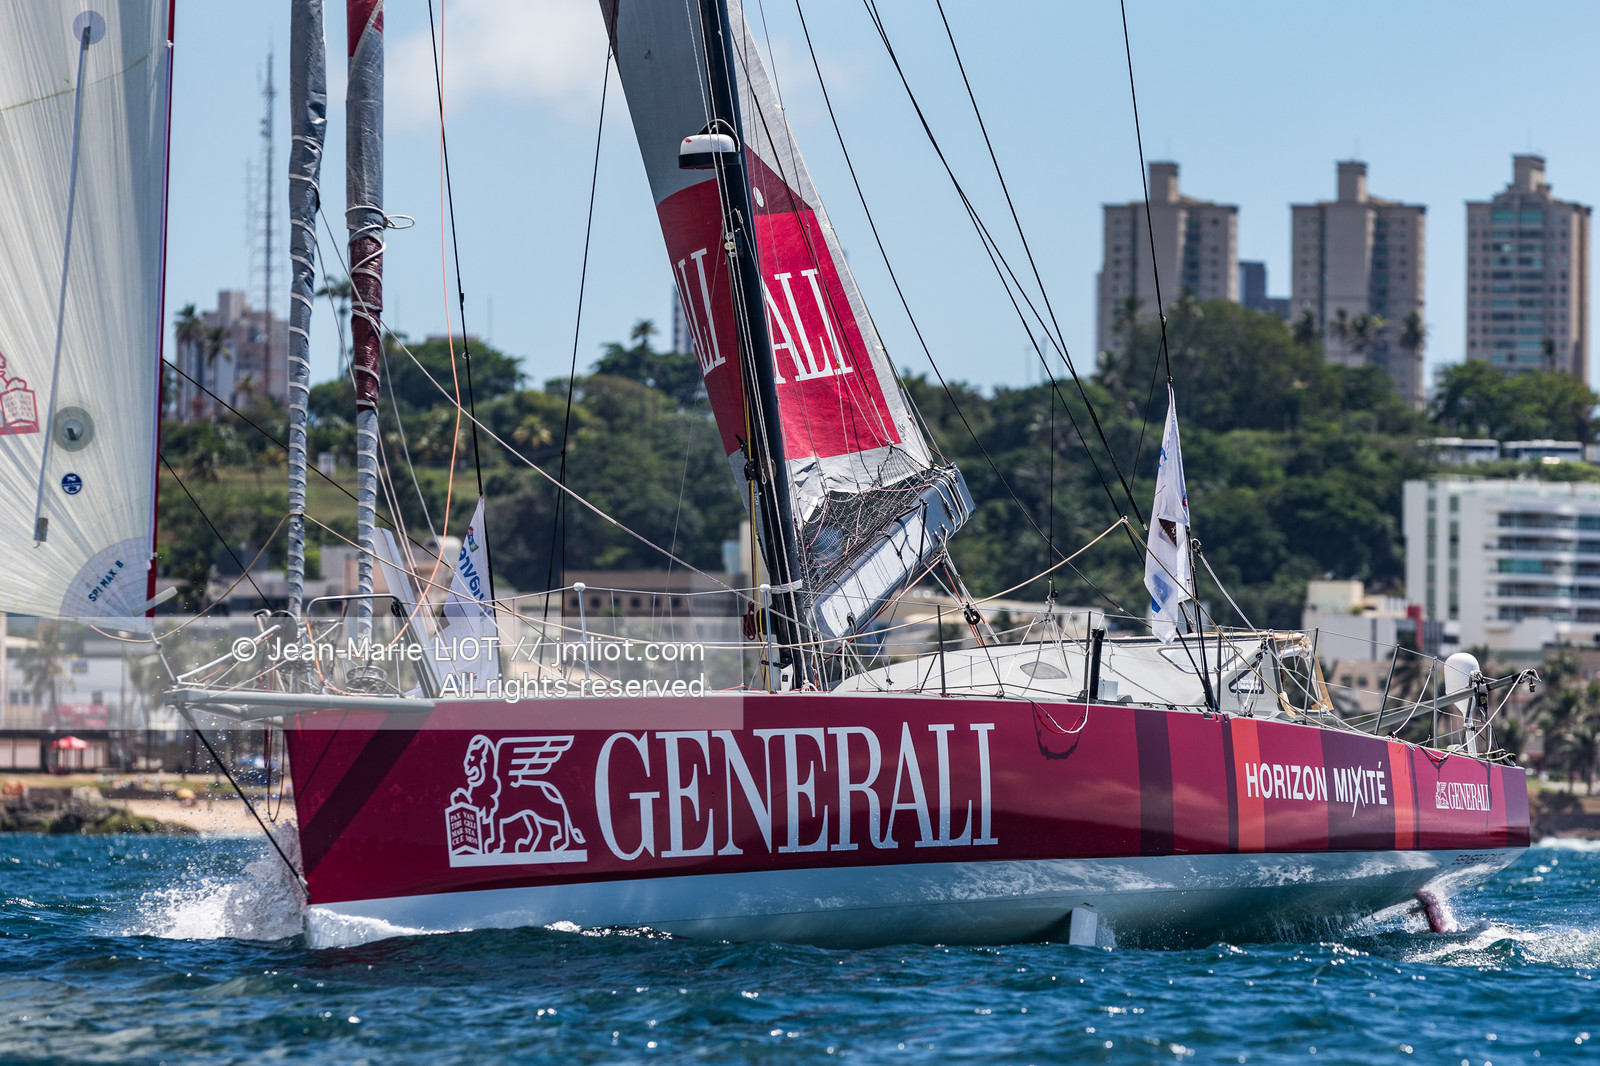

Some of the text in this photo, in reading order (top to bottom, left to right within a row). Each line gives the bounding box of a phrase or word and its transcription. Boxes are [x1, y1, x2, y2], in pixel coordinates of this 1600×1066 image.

[594, 721, 999, 861] GENERALI
[1245, 761, 1388, 818] HORIZON MIXITÉ
[1448, 782, 1491, 812] GENERALI
